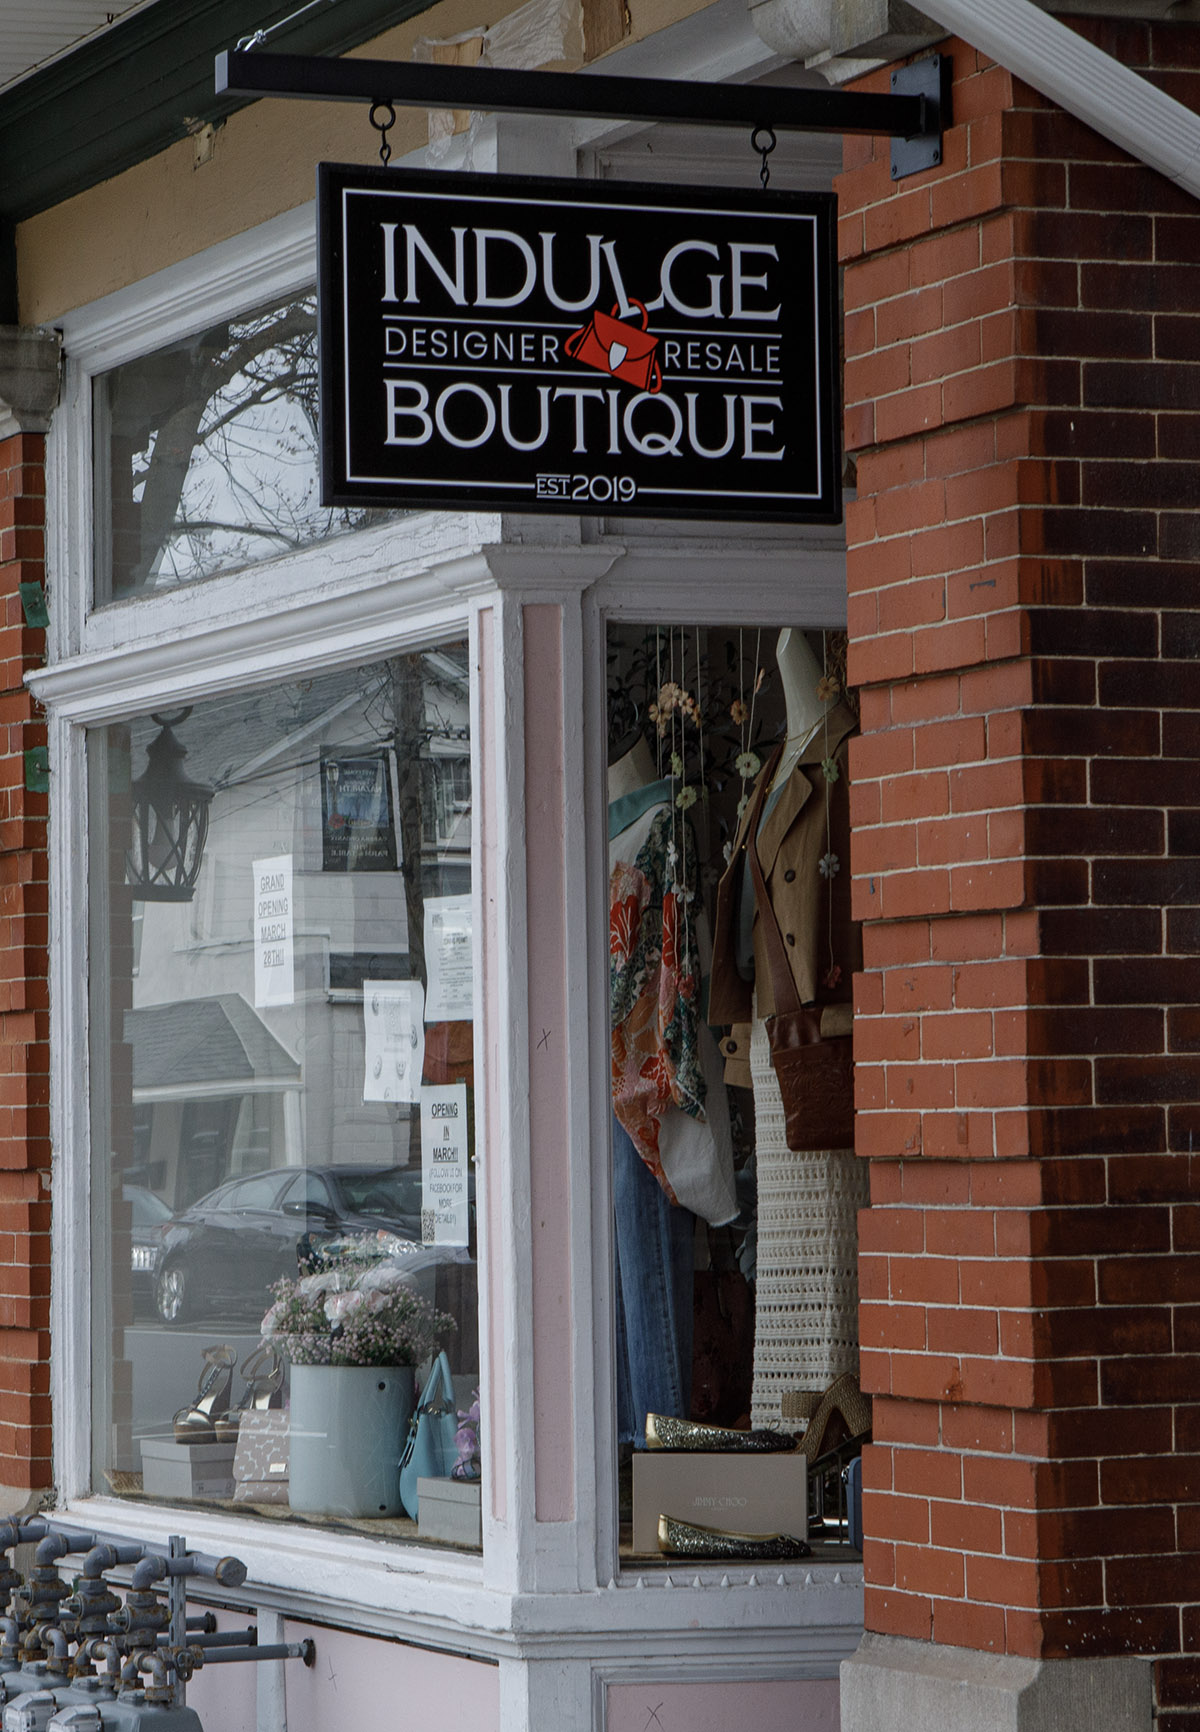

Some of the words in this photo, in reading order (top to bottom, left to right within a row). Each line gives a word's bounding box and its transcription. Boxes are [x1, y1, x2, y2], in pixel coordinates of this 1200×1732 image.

[380, 222, 782, 320] INDULGE
[385, 327, 560, 363] DESIGNER
[664, 340, 781, 372] RESALE
[383, 378, 787, 461] BOUTIQUE
[536, 477, 570, 496] EST
[572, 475, 636, 502] 2019
[260, 873, 285, 892] GRAND
[258, 897, 288, 917] OPENING
[261, 923, 286, 940] MARCH
[443, 1125, 450, 1138] IN
